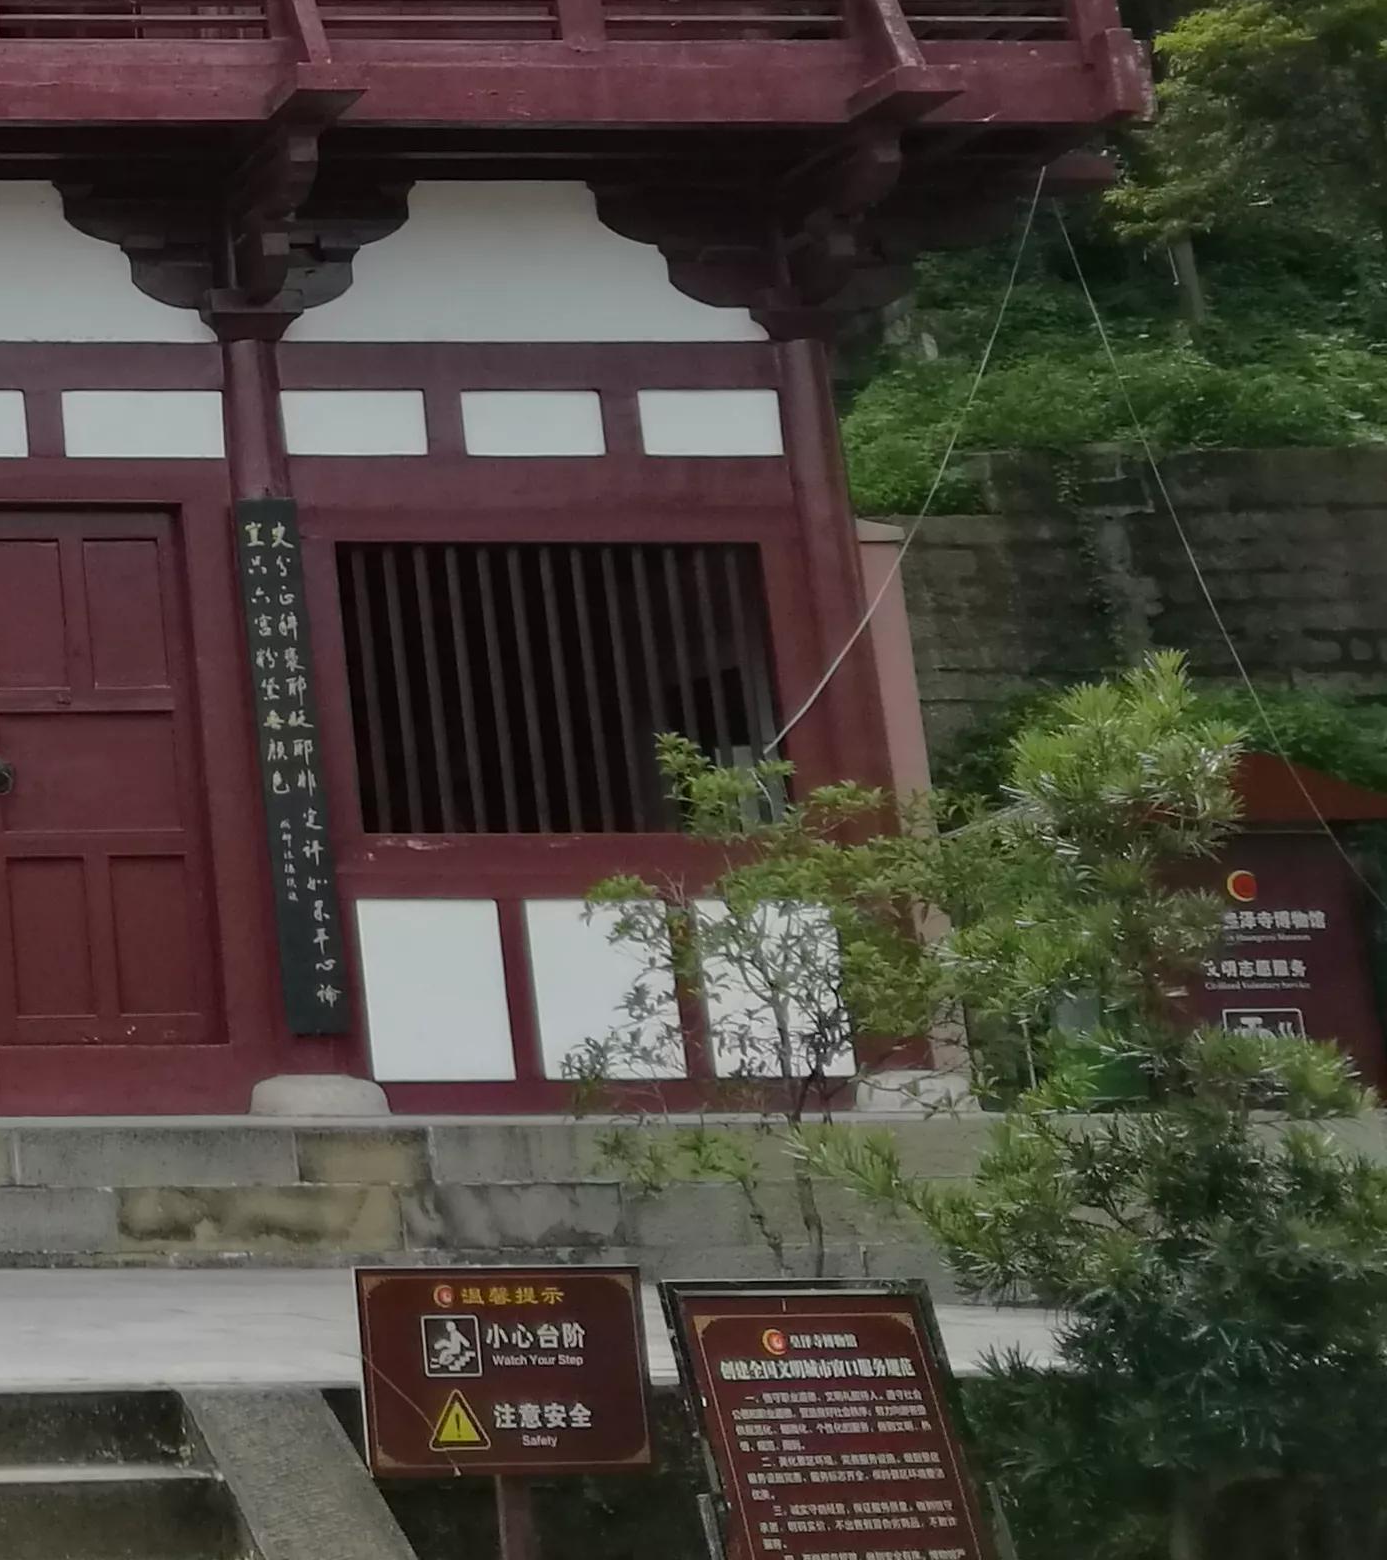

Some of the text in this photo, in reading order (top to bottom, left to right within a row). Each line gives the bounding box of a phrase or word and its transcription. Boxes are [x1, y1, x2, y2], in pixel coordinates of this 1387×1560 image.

[461, 1286, 565, 1306] 温馨提示
[485, 1321, 587, 1349] 小心台阶
[492, 1353, 584, 1368] Watch Your Step
[493, 1402, 593, 1429] 注意安全
[522, 1433, 558, 1448] Safety
